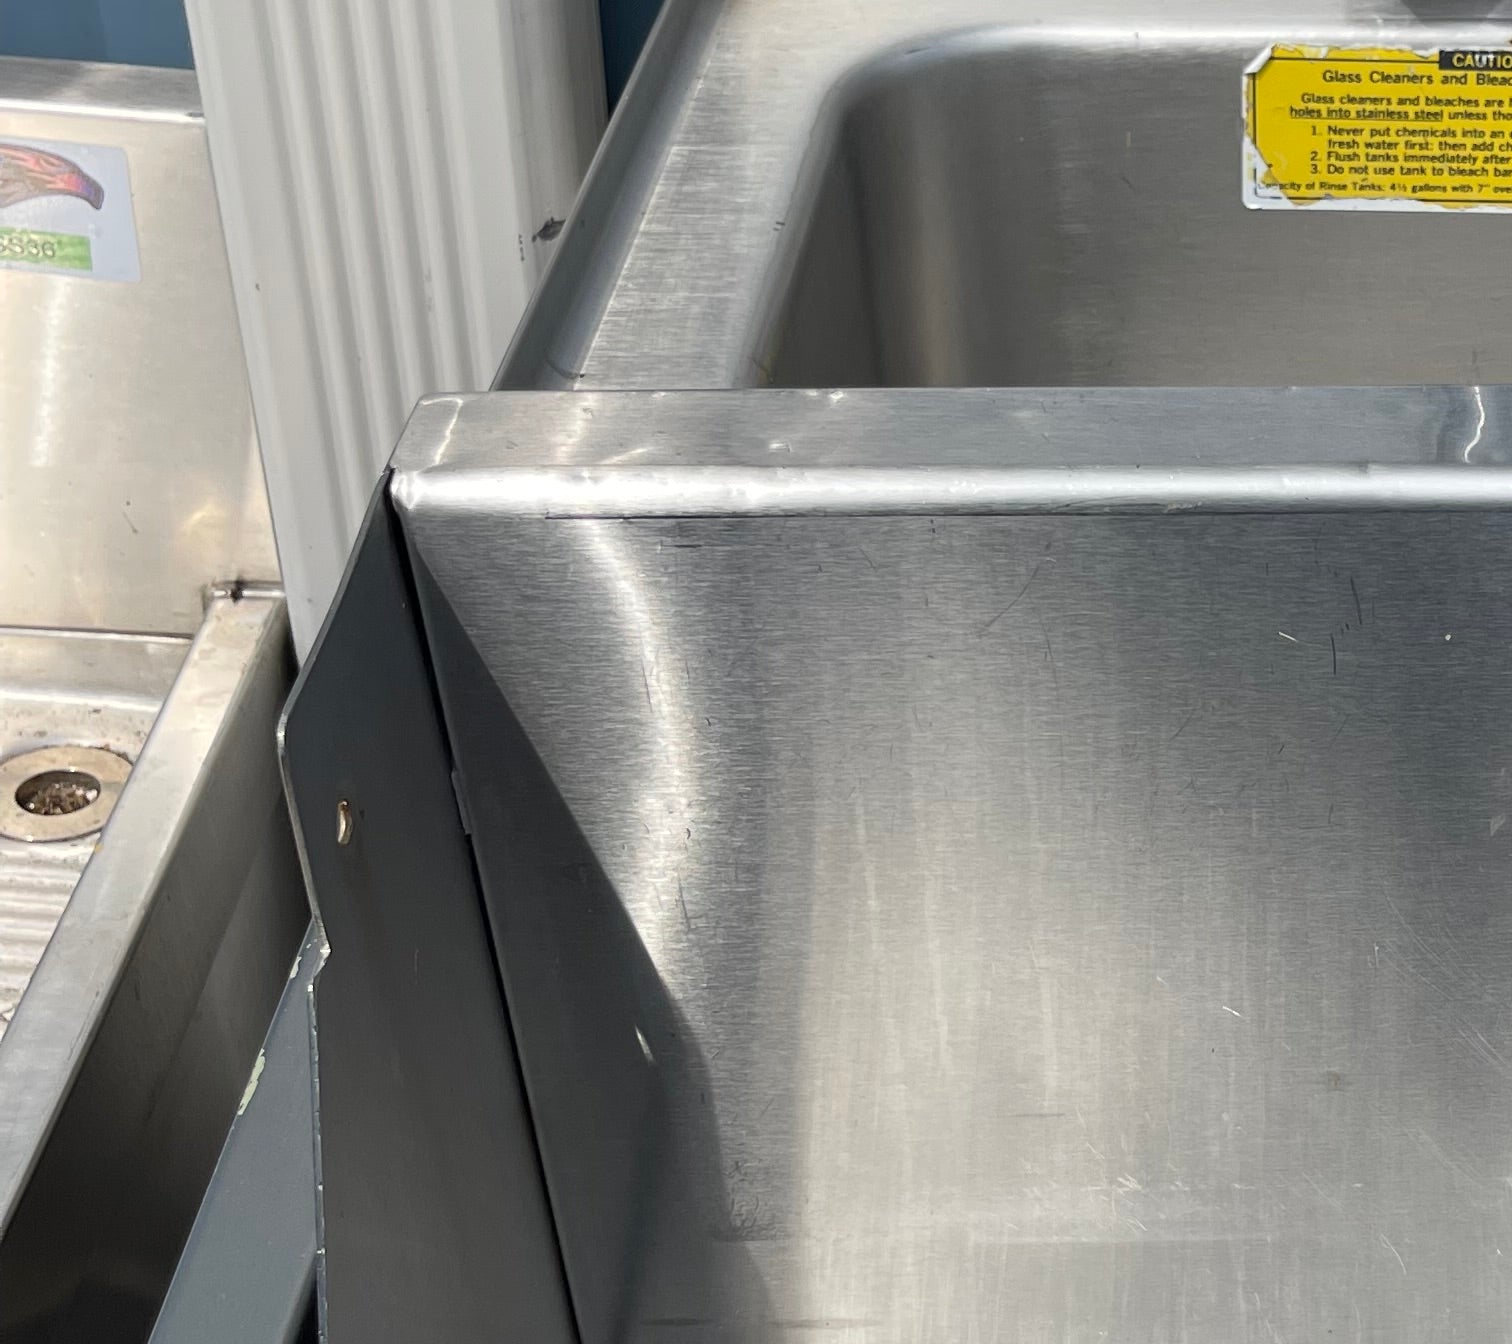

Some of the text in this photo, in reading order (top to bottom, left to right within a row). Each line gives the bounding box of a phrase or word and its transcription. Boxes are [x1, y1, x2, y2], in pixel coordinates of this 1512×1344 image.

[1322, 70, 1361, 84] Glass
[1369, 70, 1434, 85] Cleaners
[1441, 73, 1467, 86] and
[1301, 92, 1334, 105] Glass
[1340, 94, 1392, 106] cleaners
[1397, 95, 1420, 106] and
[1425, 96, 1478, 108] bleaches
[1485, 99, 1504, 108] are
[1290, 106, 1322, 119] holes
[1327, 107, 1351, 119] into
[1356, 108, 1409, 120] stainless
[1414, 109, 1443, 121] steel
[1449, 110, 1487, 121] unless
[1328, 126, 1365, 137] Never
[1370, 127, 1390, 139] put
[1396, 127, 1457, 138] chemicals
[1462, 128, 1485, 138] into
[1490, 130, 1504, 139] an
[1328, 139, 1359, 149] fresh
[1365, 140, 1399, 150] water
[1439, 141, 1466, 151] then
[1471, 142, 1494, 152] add
[1327, 151, 1360, 162] Flush
[1366, 152, 1399, 162] tanks
[1404, 152, 1478, 166] immediately
[1482, 155, 1512, 165] after
[1310, 164, 1321, 174] 3.
[1327, 164, 1344, 174] Do
[1349, 165, 1370, 175] not
[1374, 166, 1395, 176] use
[1400, 165, 1427, 176] tank
[1432, 166, 1443, 176] to
[1449, 166, 1489, 177] bleach
[1494, 167, 1512, 177] bar
[1306, 181, 1315, 190] of
[1319, 181, 1348, 191] Rinse
[1411, 183, 1447, 193] gallons
[1451, 183, 1473, 193] with
